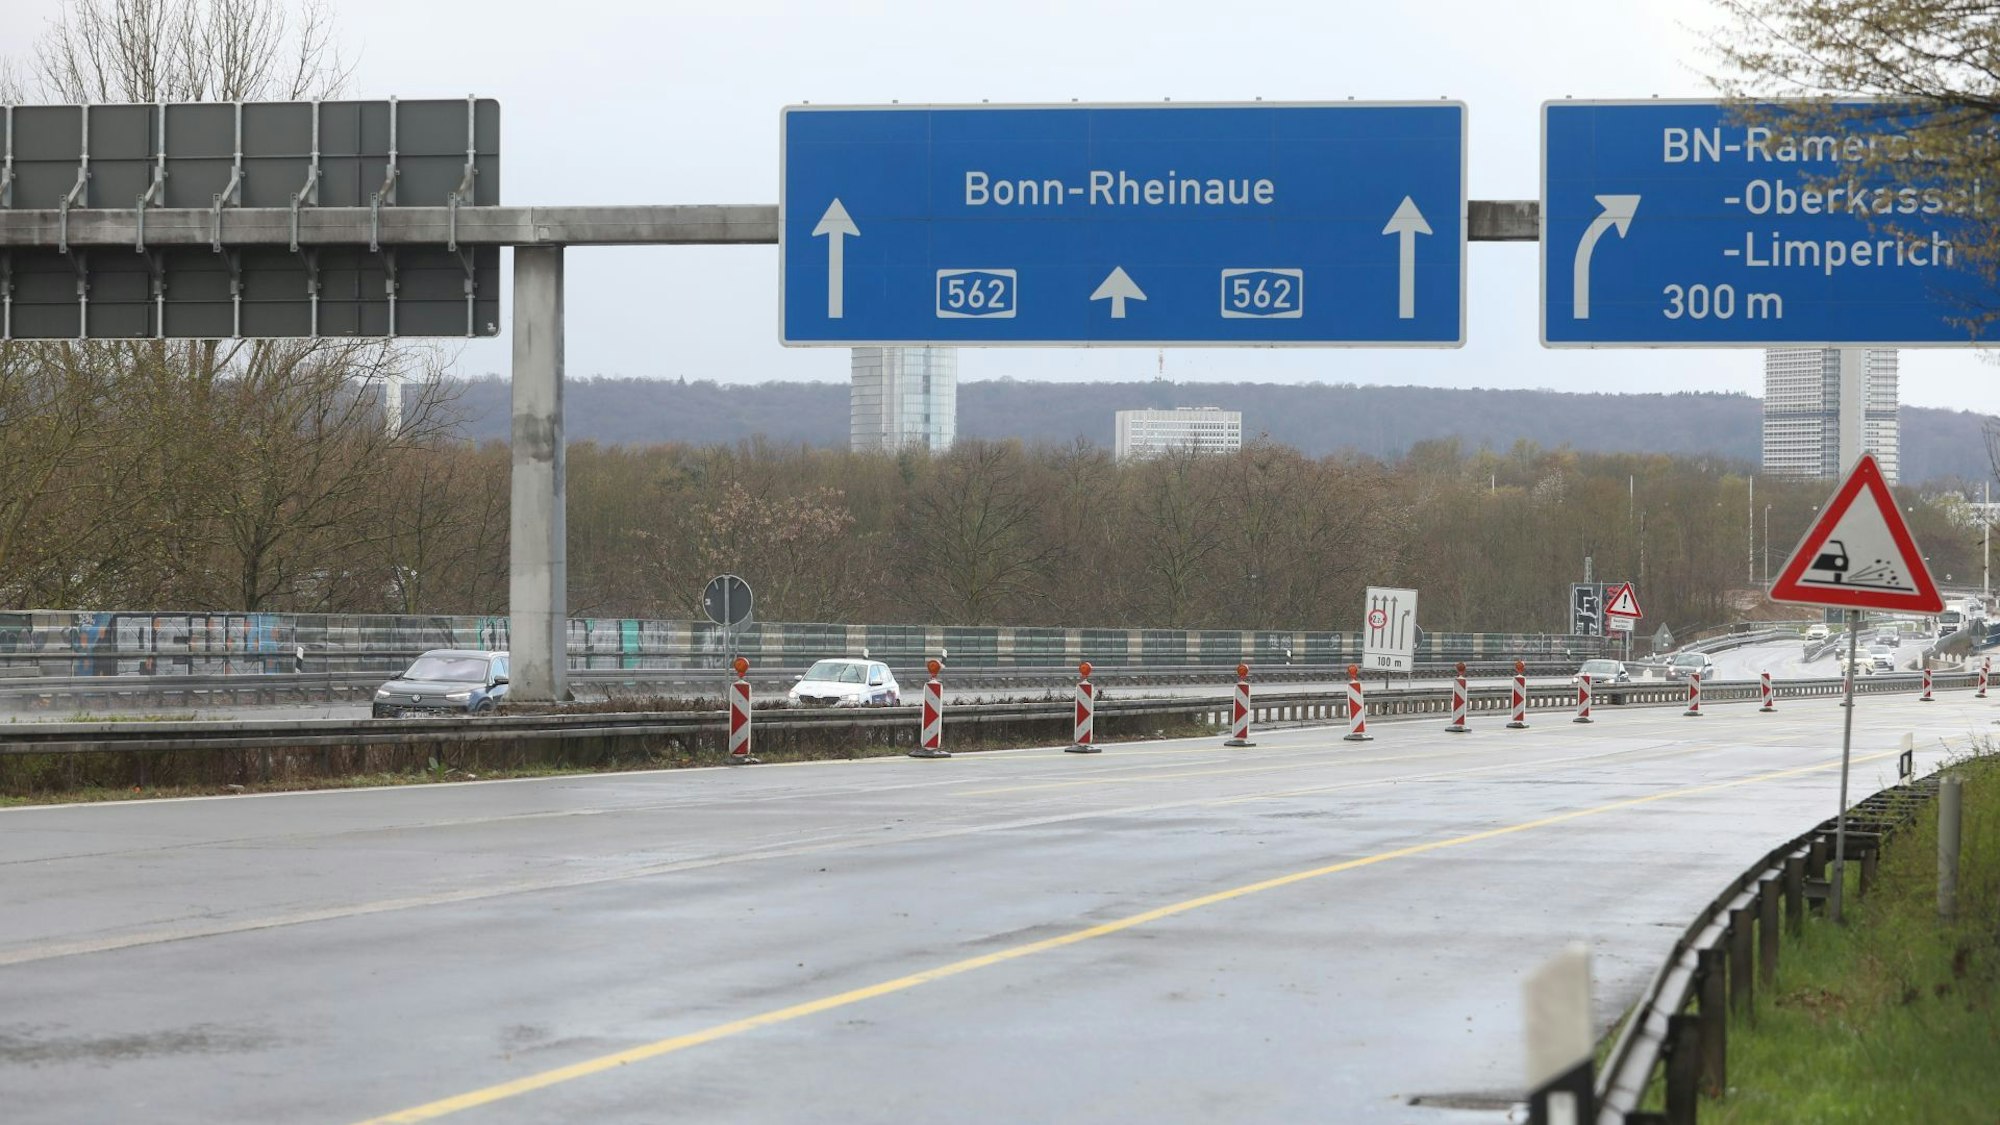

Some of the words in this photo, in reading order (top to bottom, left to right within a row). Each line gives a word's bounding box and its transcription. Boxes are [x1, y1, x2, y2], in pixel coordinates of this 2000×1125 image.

[965, 171, 1275, 205] Bonn-Rheinaue
[1724, 232, 1954, 276] -Limperich
[947, 280, 1005, 308] 562
[1232, 280, 1291, 308] 562
[1663, 284, 1735, 319] 300
[1747, 292, 1783, 319] m
[1378, 656, 1391, 666] 100
